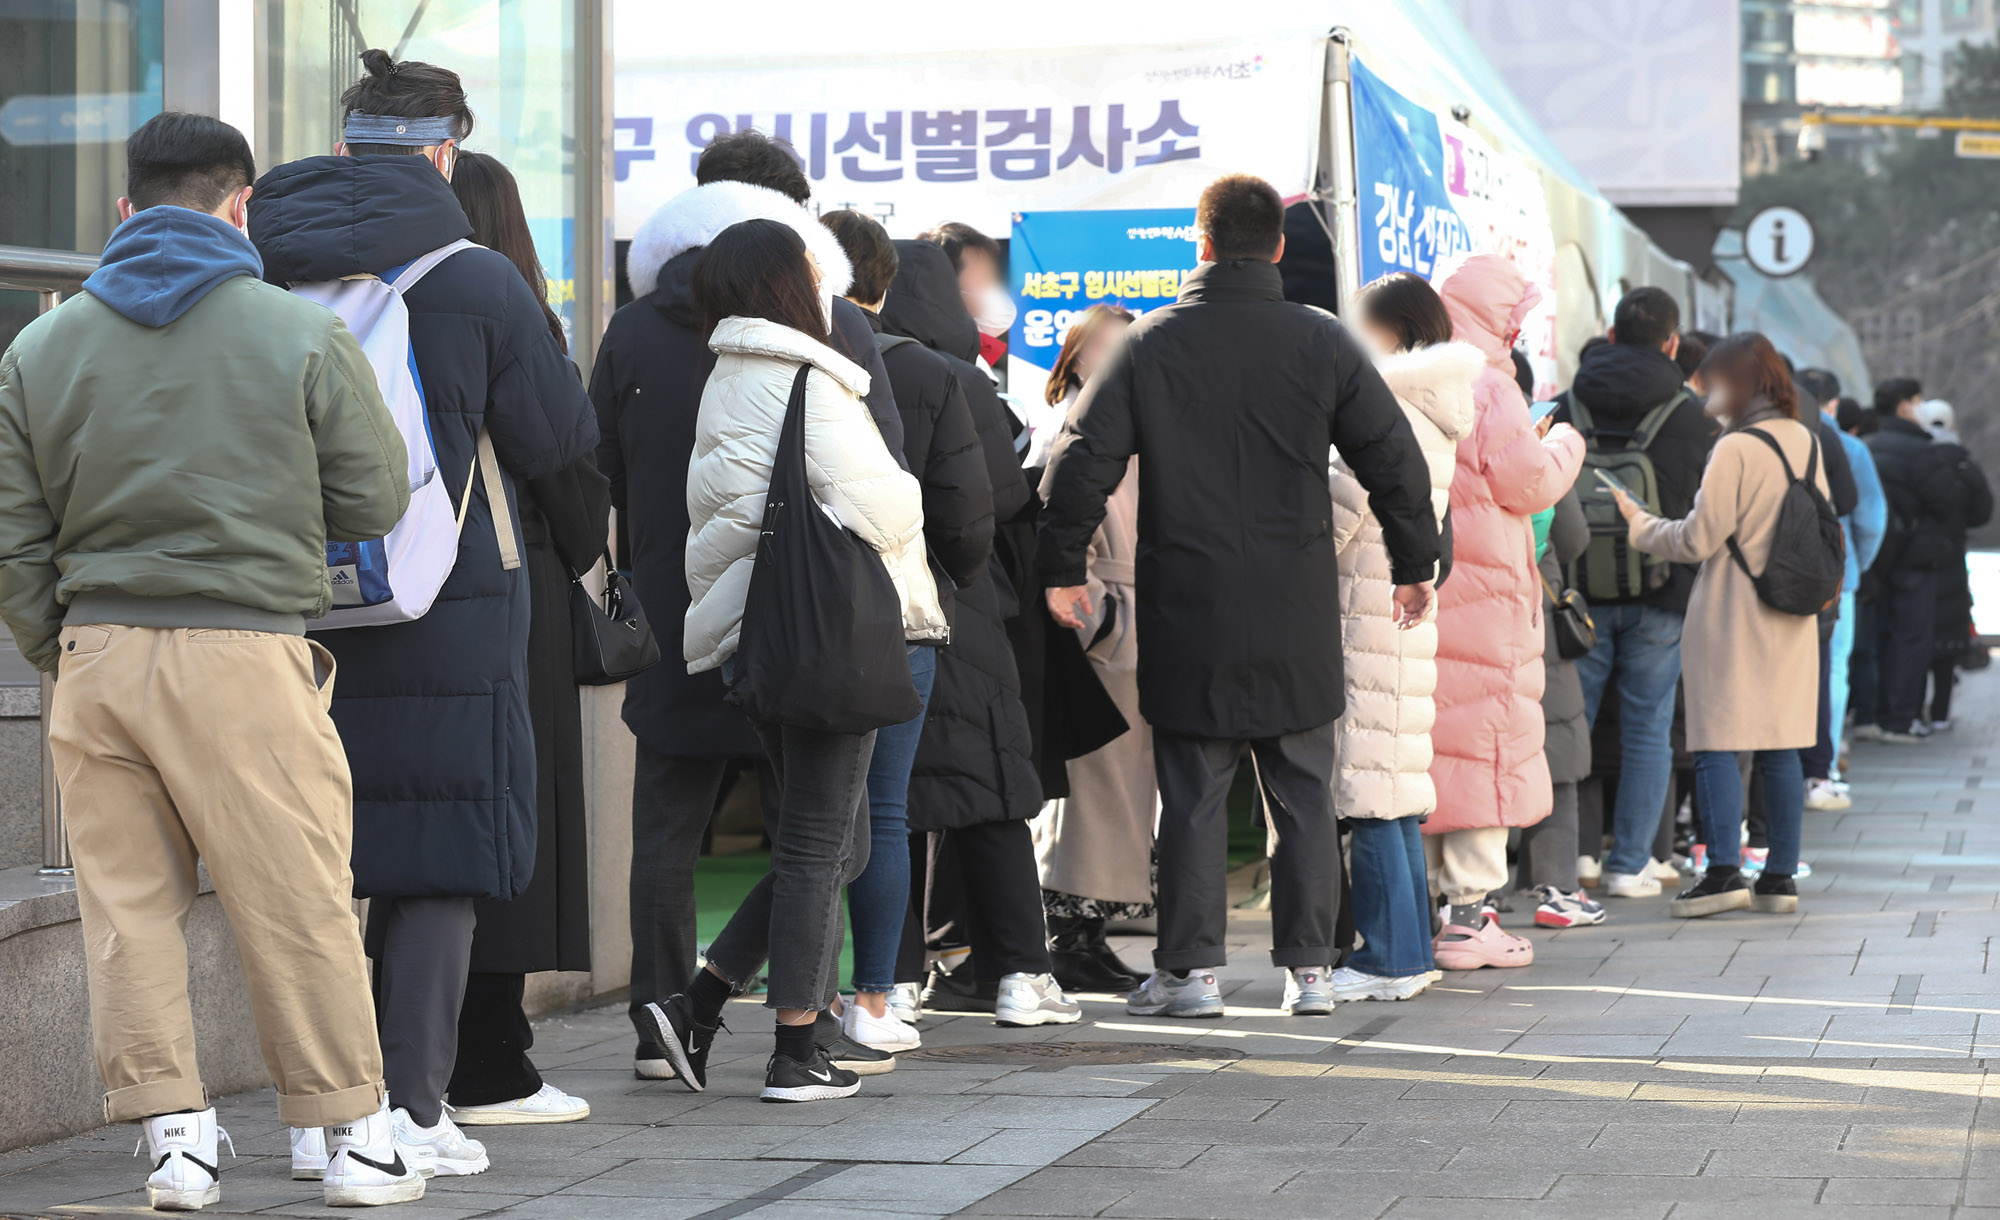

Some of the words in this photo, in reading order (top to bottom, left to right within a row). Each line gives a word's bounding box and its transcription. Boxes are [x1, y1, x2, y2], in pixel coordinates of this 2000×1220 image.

[1021, 272, 1080, 299] 서초구
[1084, 269, 1192, 299] 임시선별검
[164, 1126, 186, 1138] NIKE
[332, 1126, 353, 1137] NIKE
